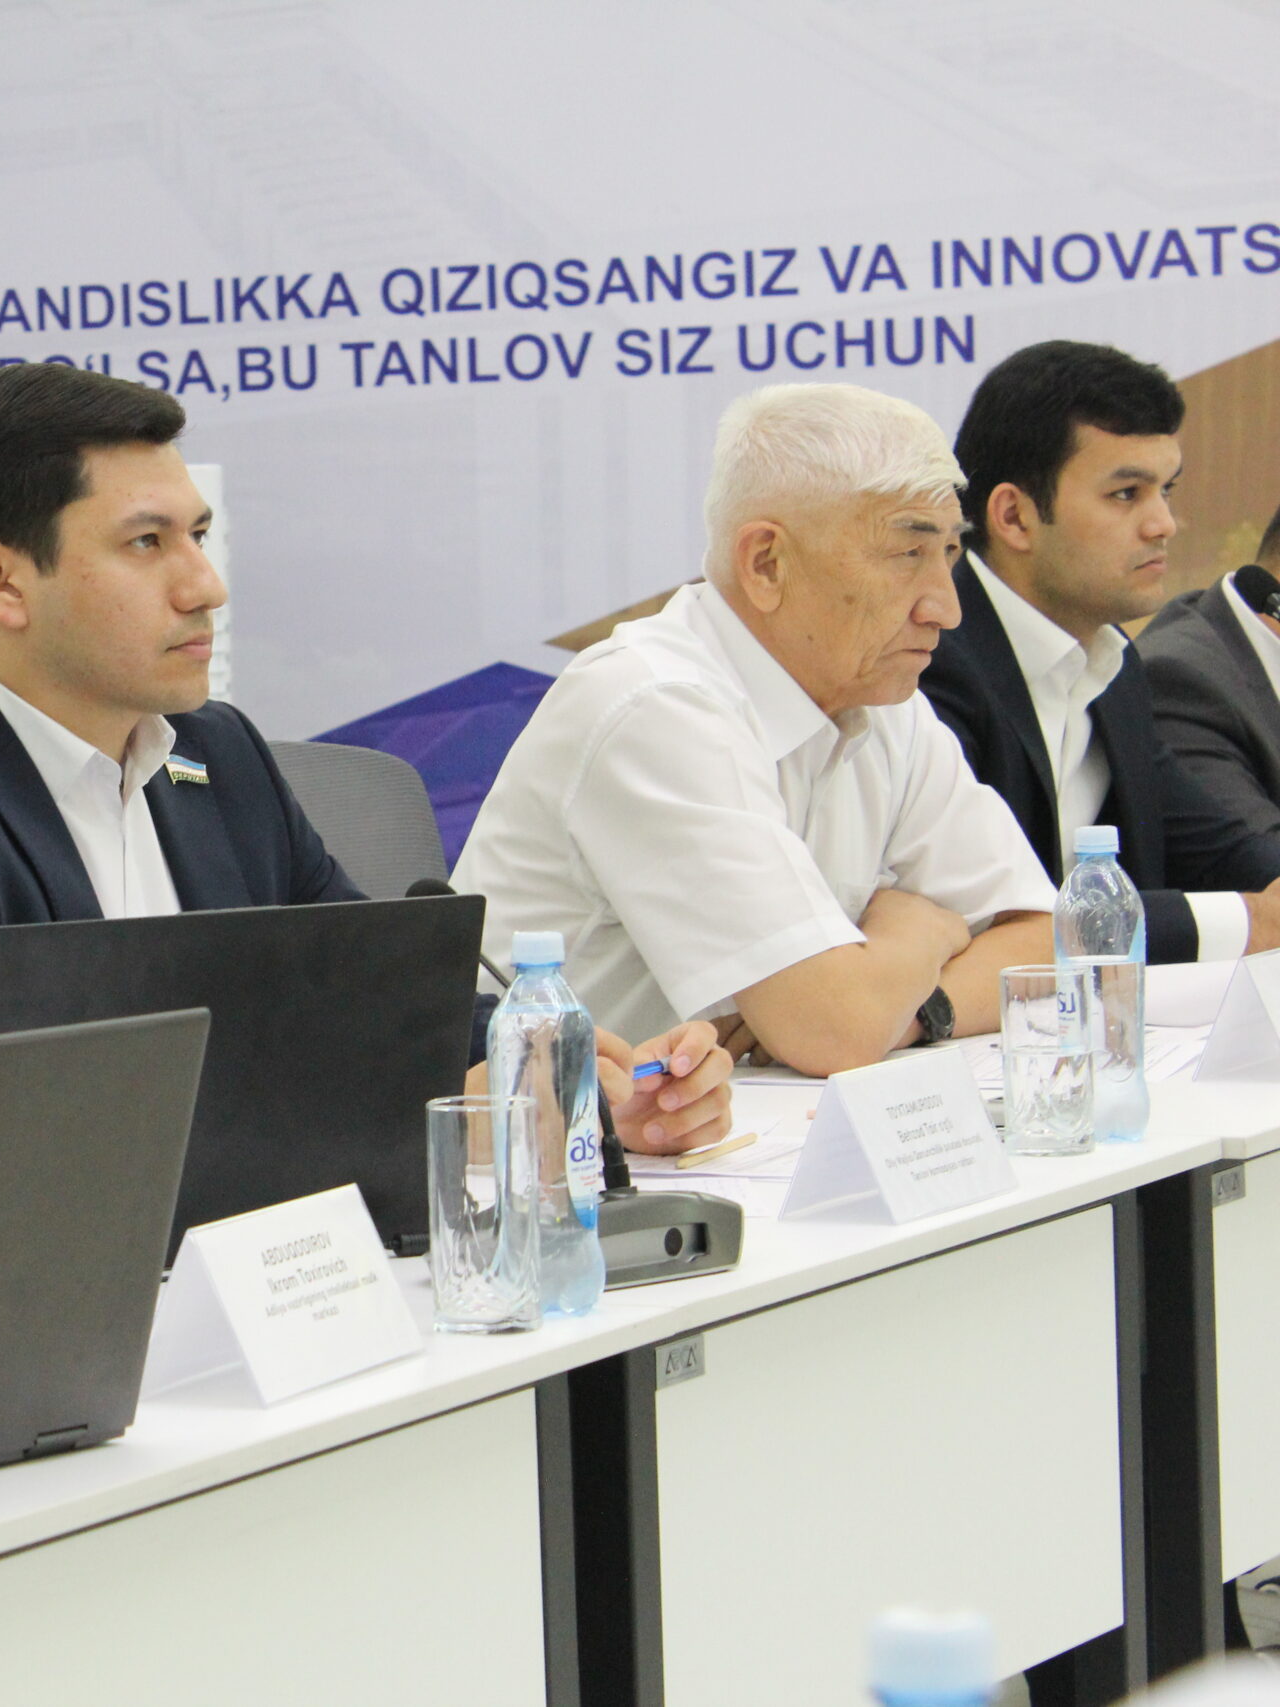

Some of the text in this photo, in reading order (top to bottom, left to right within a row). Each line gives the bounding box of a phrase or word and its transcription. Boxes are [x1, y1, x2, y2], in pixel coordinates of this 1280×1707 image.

[380, 248, 799, 318] QIZIQSANGIZ
[820, 244, 907, 294] VA
[340, 331, 592, 388] TANLOV
[616, 326, 714, 377] SIZ
[738, 314, 975, 372] UCHUN
